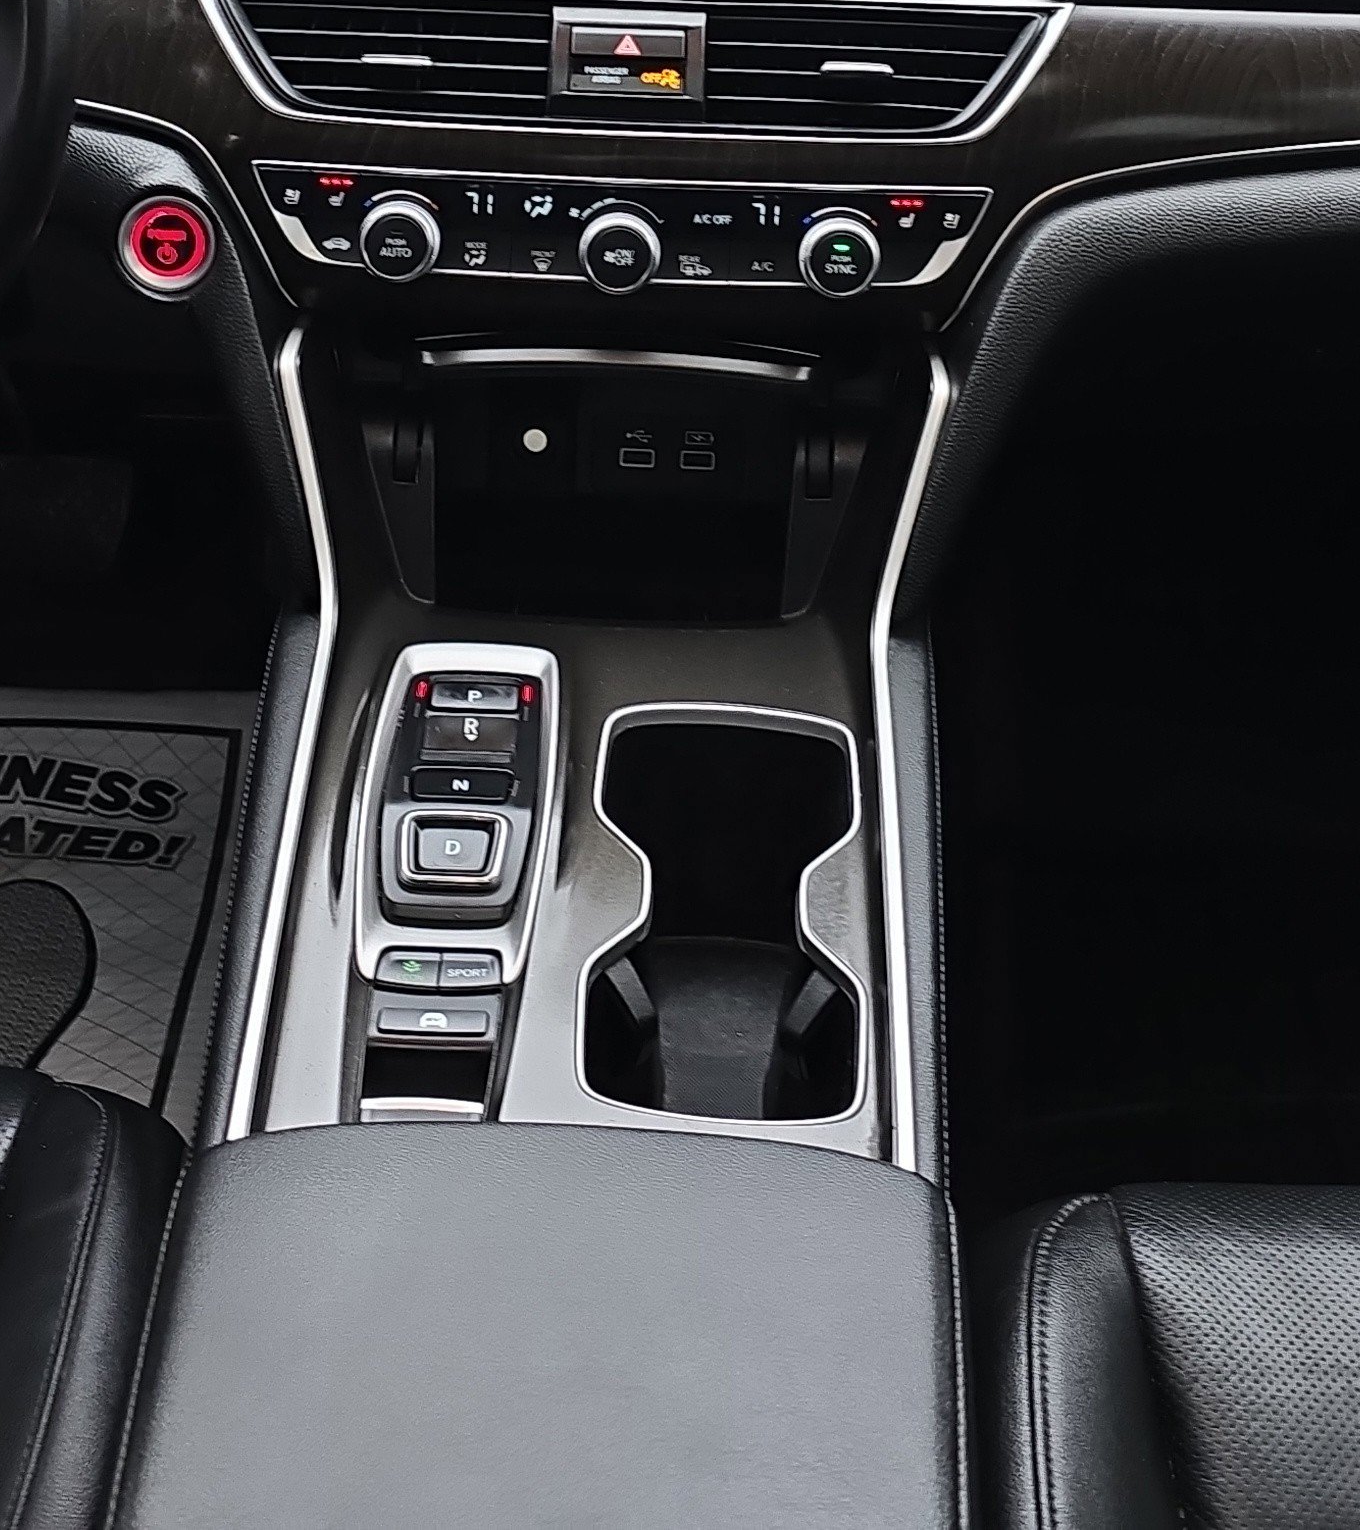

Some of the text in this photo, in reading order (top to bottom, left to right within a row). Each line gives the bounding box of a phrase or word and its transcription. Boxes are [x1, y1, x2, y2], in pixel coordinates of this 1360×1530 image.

[464, 191, 494, 215] 71
[712, 214, 733, 225] OFF
[751, 202, 781, 226] 71
[378, 247, 413, 258] AUTO
[678, 254, 701, 263] REAR
[750, 261, 775, 272] A/C
[824, 263, 858, 275] SYNC
[467, 689, 483, 704] P
[463, 717, 480, 735] R
[451, 778, 471, 792] N
[444, 839, 461, 856] D
[446, 968, 489, 978] SPORT
